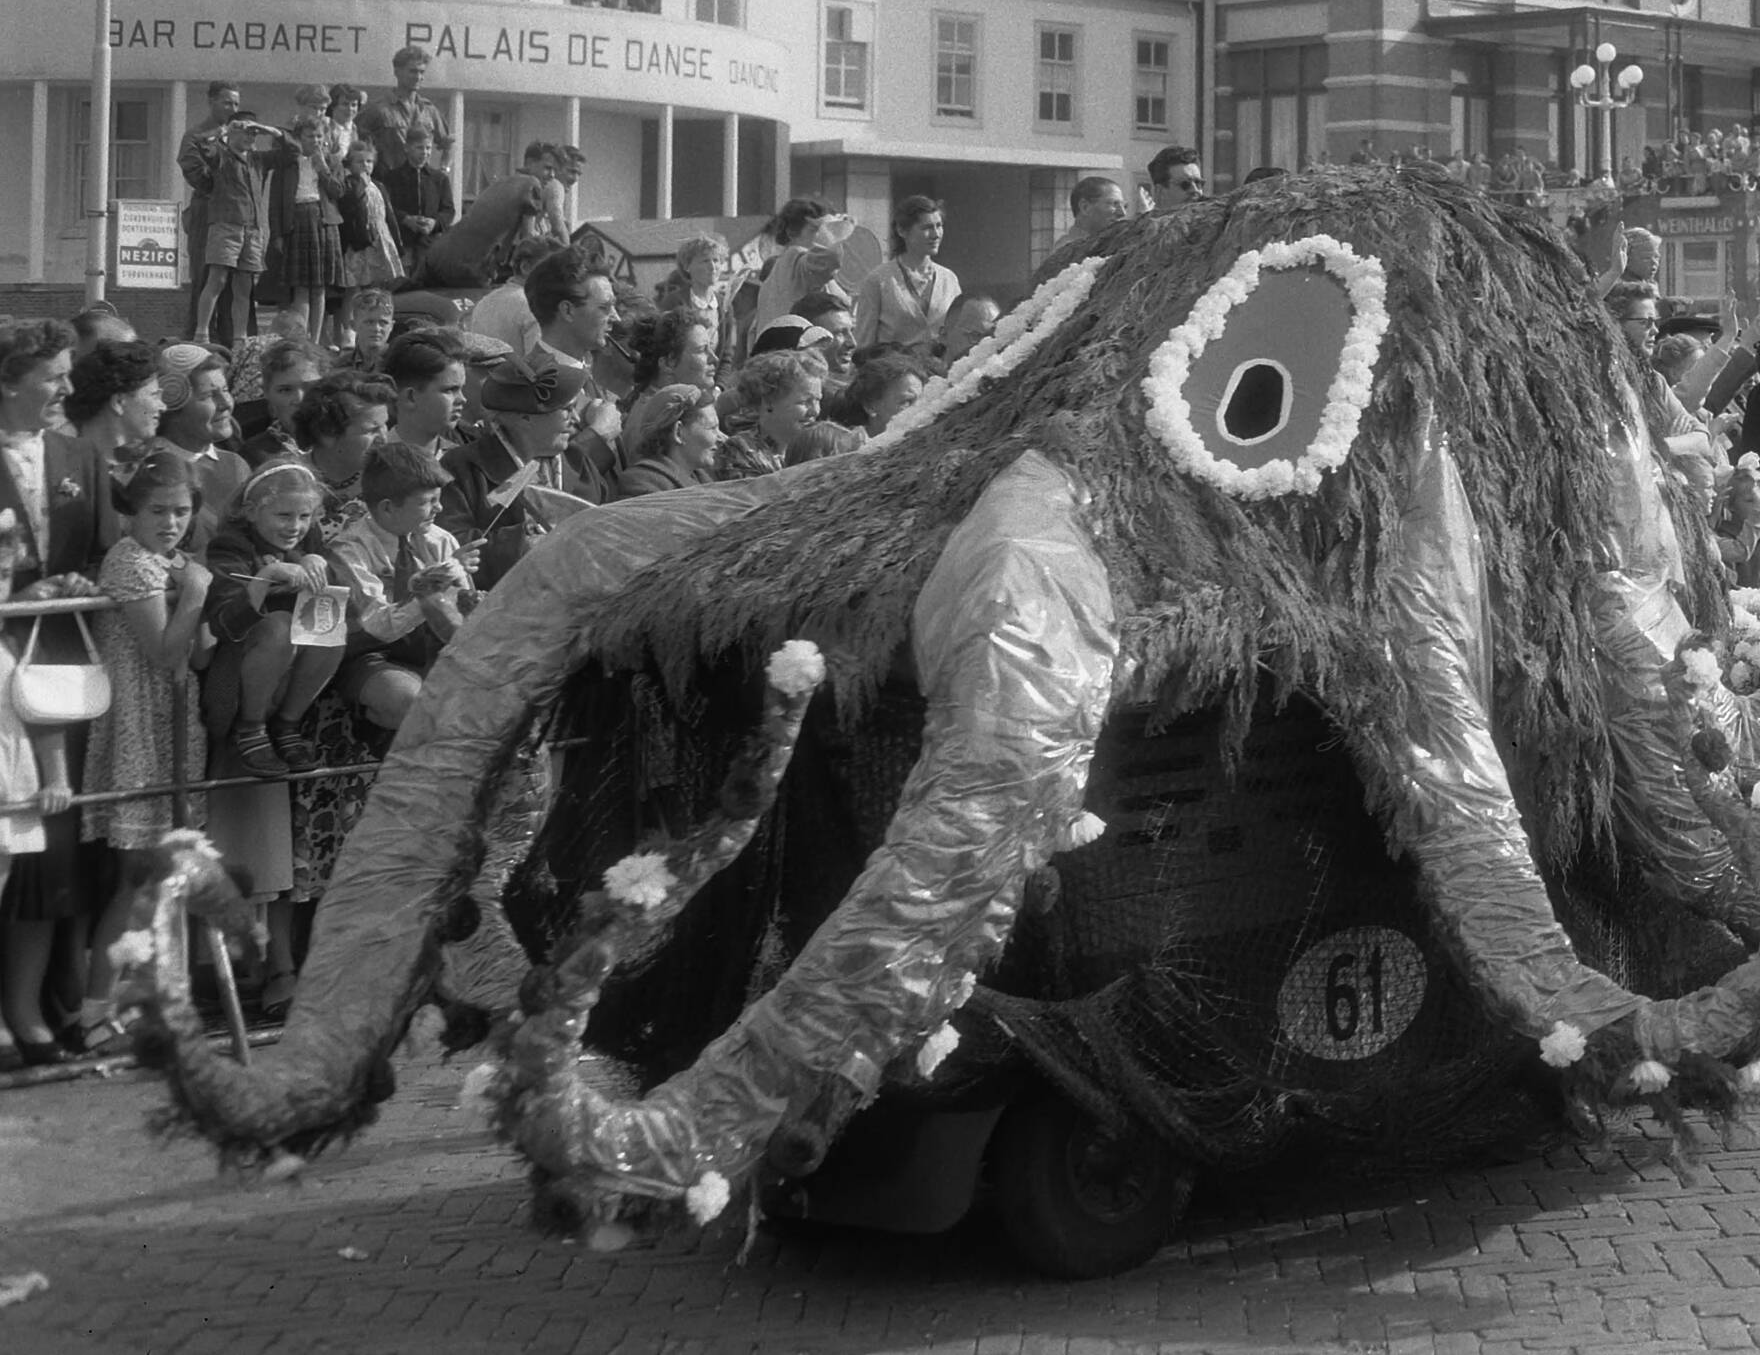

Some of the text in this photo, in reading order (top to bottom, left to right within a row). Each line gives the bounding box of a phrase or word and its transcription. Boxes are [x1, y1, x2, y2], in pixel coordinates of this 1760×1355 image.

[109, 19, 175, 48] BAR
[193, 21, 368, 54] CABARET
[405, 22, 550, 64] PALAIS
[568, 34, 611, 69] DE
[625, 38, 713, 81] DANSE
[121, 249, 176, 263] NEZIFO
[1326, 946, 1382, 1041] 61
